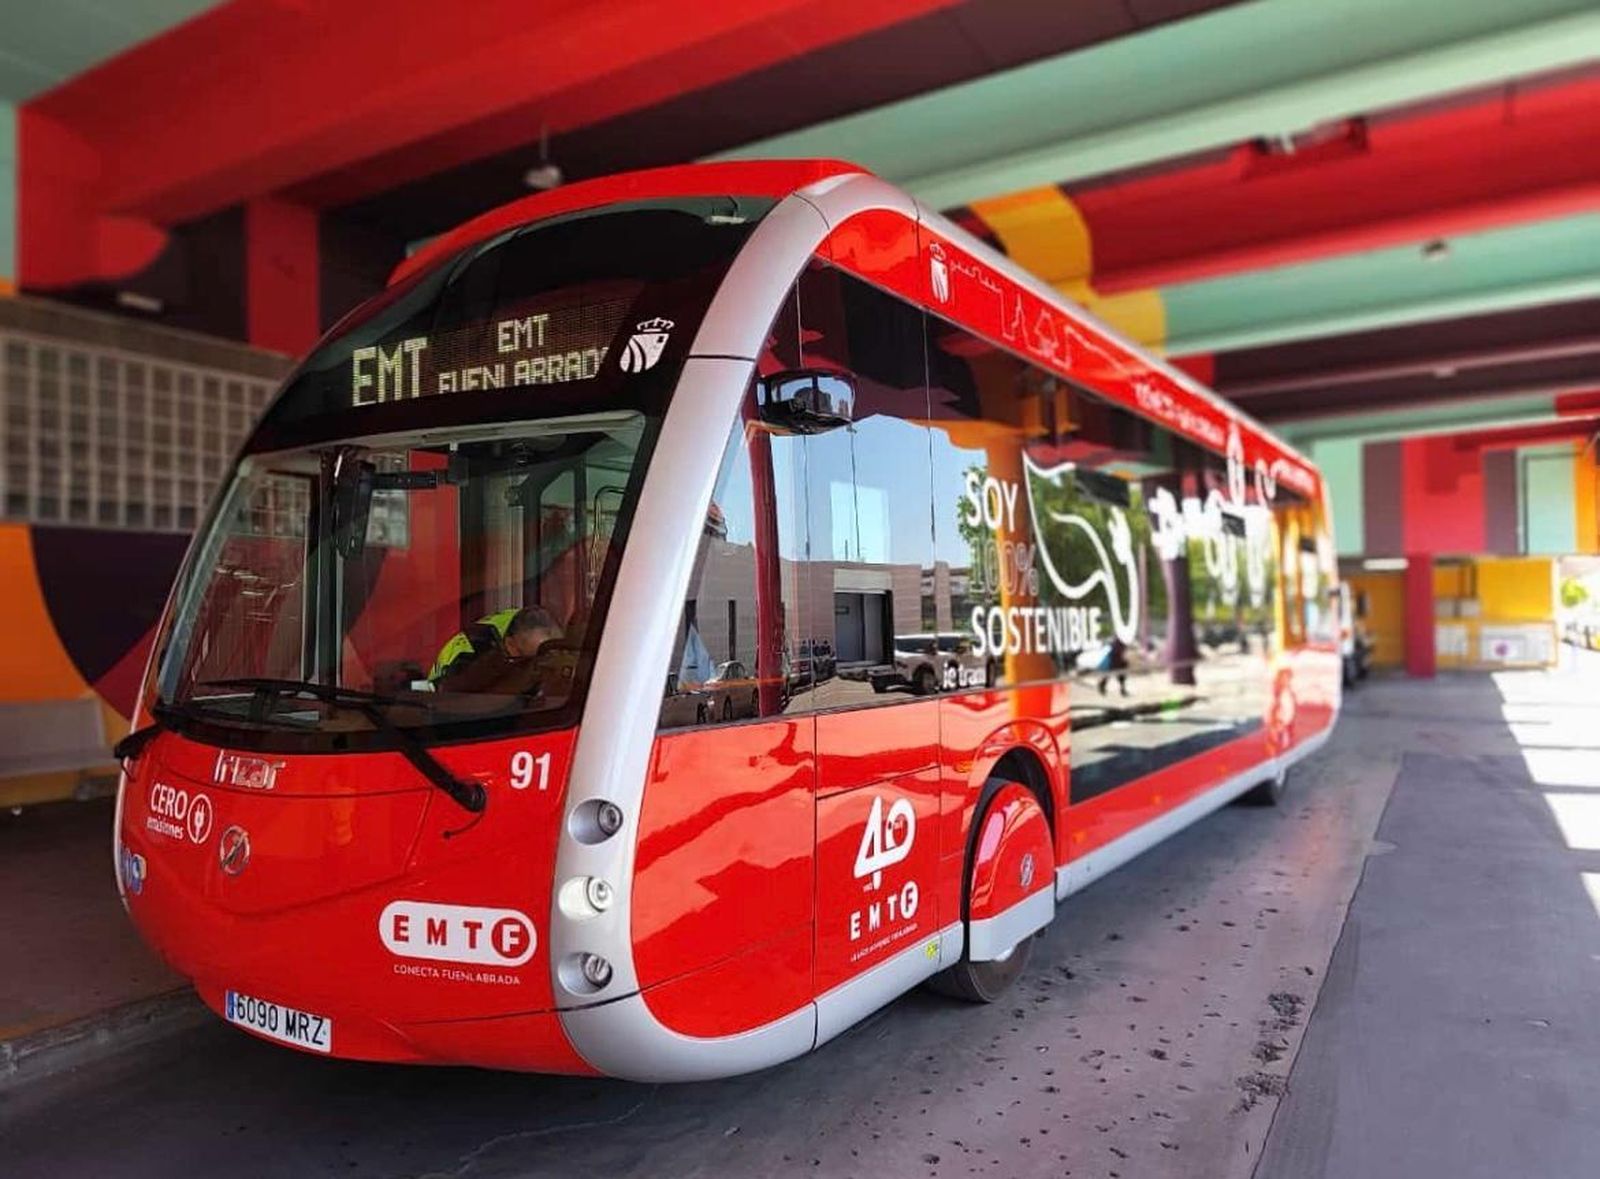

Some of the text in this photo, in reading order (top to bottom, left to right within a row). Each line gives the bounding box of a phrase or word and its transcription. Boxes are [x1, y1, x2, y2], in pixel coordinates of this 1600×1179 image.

[497, 313, 549, 352] EMT
[353, 336, 428, 407] EMT
[964, 471, 1018, 533] SOY
[969, 541, 1040, 597] 100%
[971, 605, 1102, 657] SOSTENIBLE
[510, 751, 551, 791] 91
[151, 782, 188, 820] CERO
[393, 963, 521, 985] CONECTA FUENLABRADA
[237, 995, 325, 1046] 6090 MRZ
